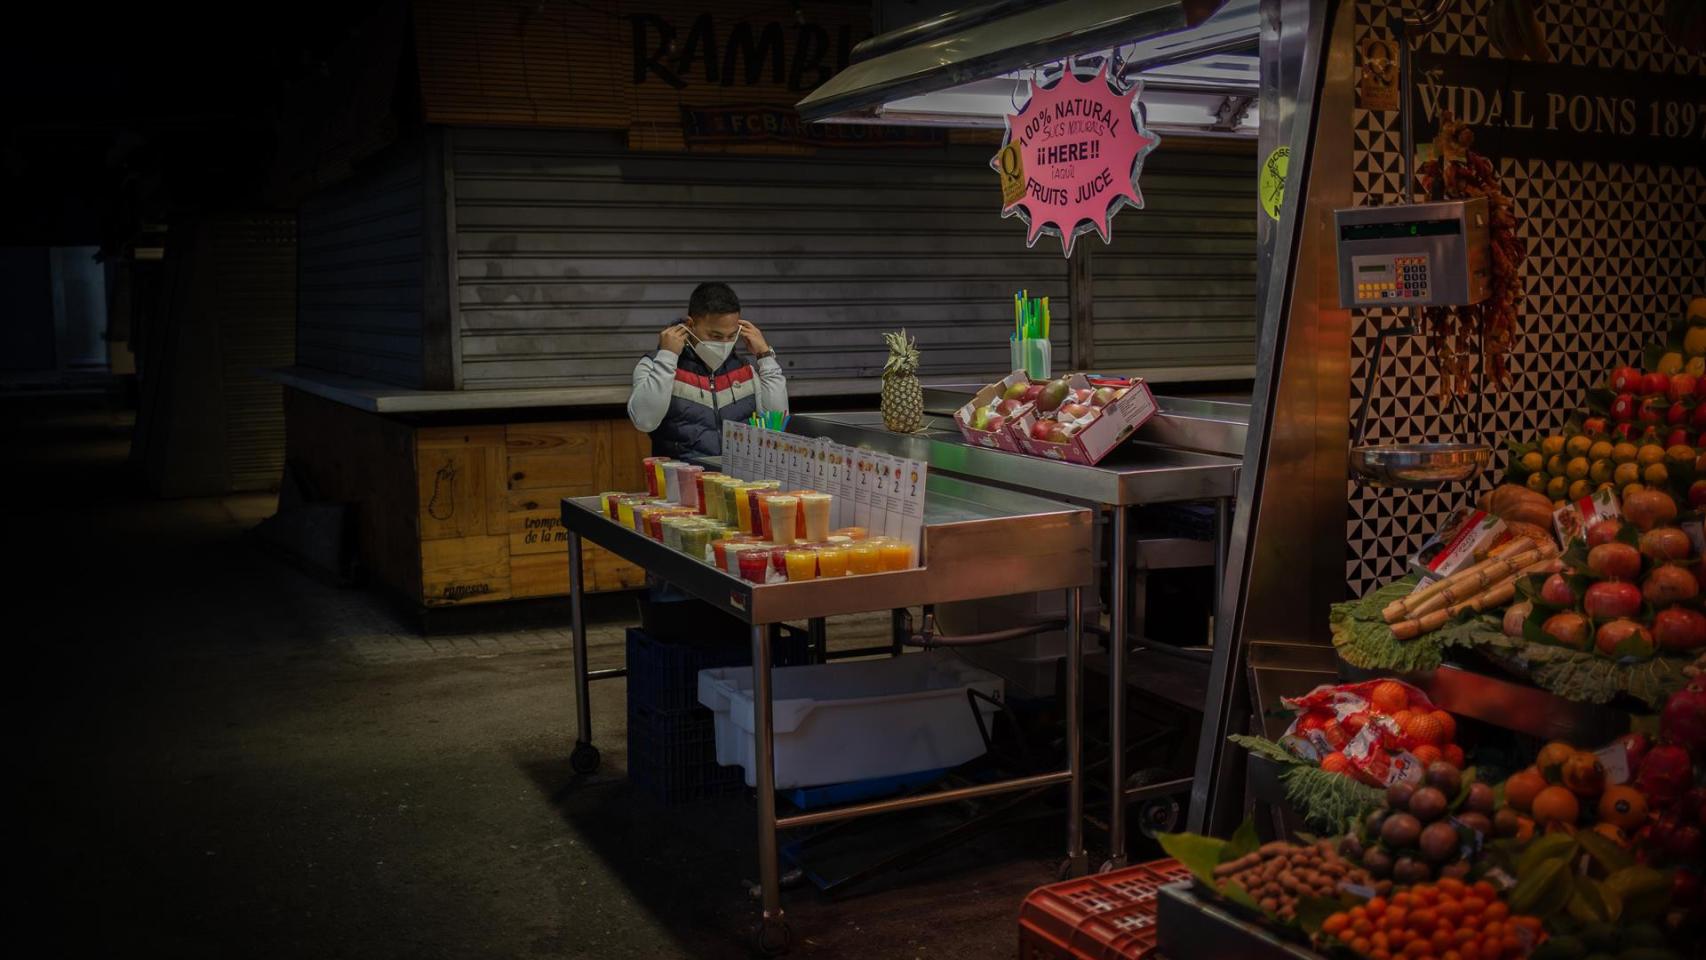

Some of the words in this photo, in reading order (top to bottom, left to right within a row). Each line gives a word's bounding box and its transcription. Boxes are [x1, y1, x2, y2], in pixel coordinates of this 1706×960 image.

[1020, 109, 1051, 147] 100%
[1055, 99, 1120, 138] NATURAL
[1416, 83, 1534, 128] VIDAL
[1545, 92, 1638, 137] PONS
[1026, 177, 1069, 206] FRUITS
[1075, 167, 1114, 204] JUICE
[541, 529, 551, 543] la
